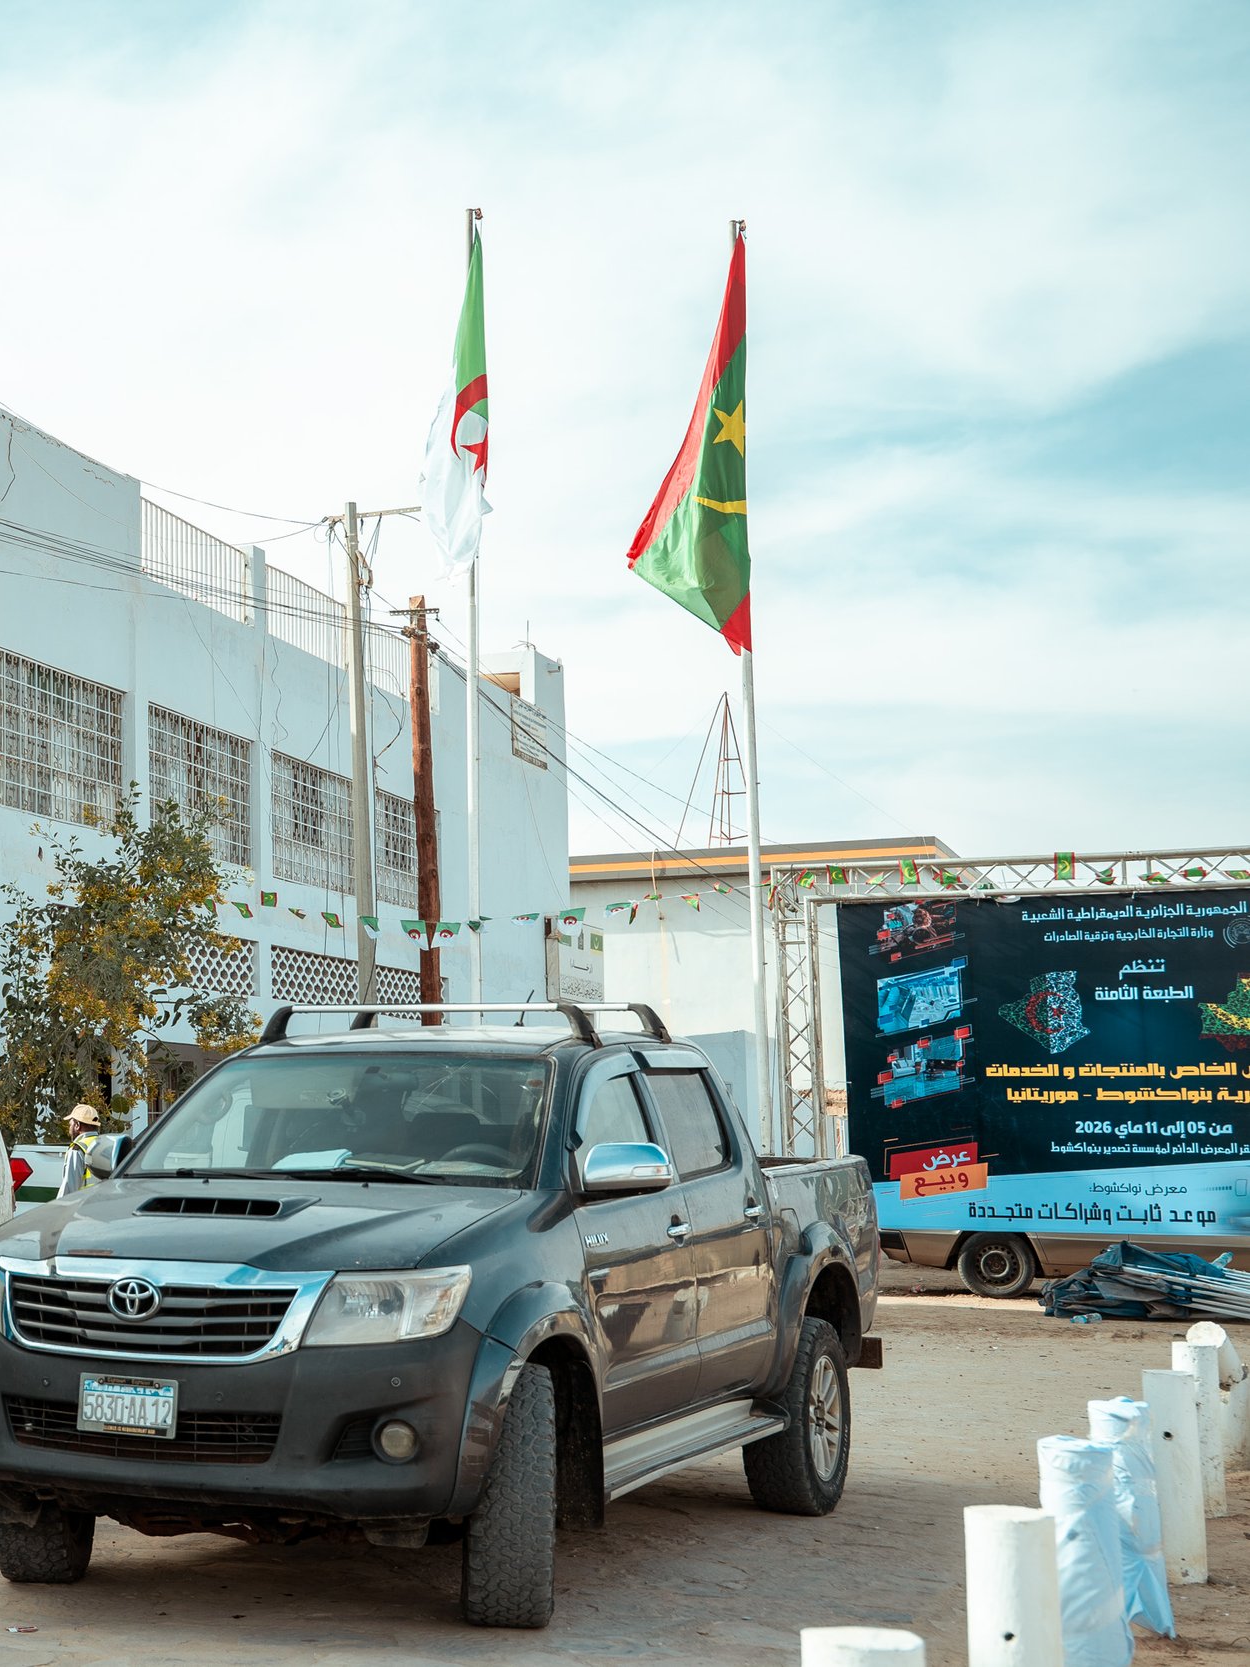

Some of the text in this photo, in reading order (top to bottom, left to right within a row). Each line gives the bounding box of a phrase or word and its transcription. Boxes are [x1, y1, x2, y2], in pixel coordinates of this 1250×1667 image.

[1022, 901, 1246, 923] الجمهورية الجزائرية الديمقراطية الشعبية
[1044, 926, 1214, 942] وزارة التجارة الخارجية وترقية الصادرات
[1118, 959, 1165, 980] تنظم
[1095, 984, 1194, 1003] الطبعة الثامنة
[986, 1064, 1059, 1077] الخدمات
[1063, 1066, 1075, 1079] و
[1079, 1063, 1165, 1079] بالمنتجات
[1170, 1062, 1237, 1079] الخاص
[1007, 1088, 1078, 1104] موريتانيا
[1096, 1087, 1212, 1104] بنواكشوط
[1075, 1121, 1233, 1138] من 05 إلى 11 ماي 2026
[1050, 1142, 1101, 1154] بنواكشوط
[1102, 1144, 1130, 1154] تصدير
[1132, 1142, 1170, 1154] لمؤسسة
[1201, 1142, 1237, 1155] المعرض
[922, 1150, 970, 1171] عرض
[914, 1172, 969, 1196] وبيع
[1089, 1182, 1188, 1196] معرض نواكشوط:
[969, 1202, 1216, 1227] موعد ثابت وشراكات متجددة
[584, 1232, 608, 1248] HILUX
